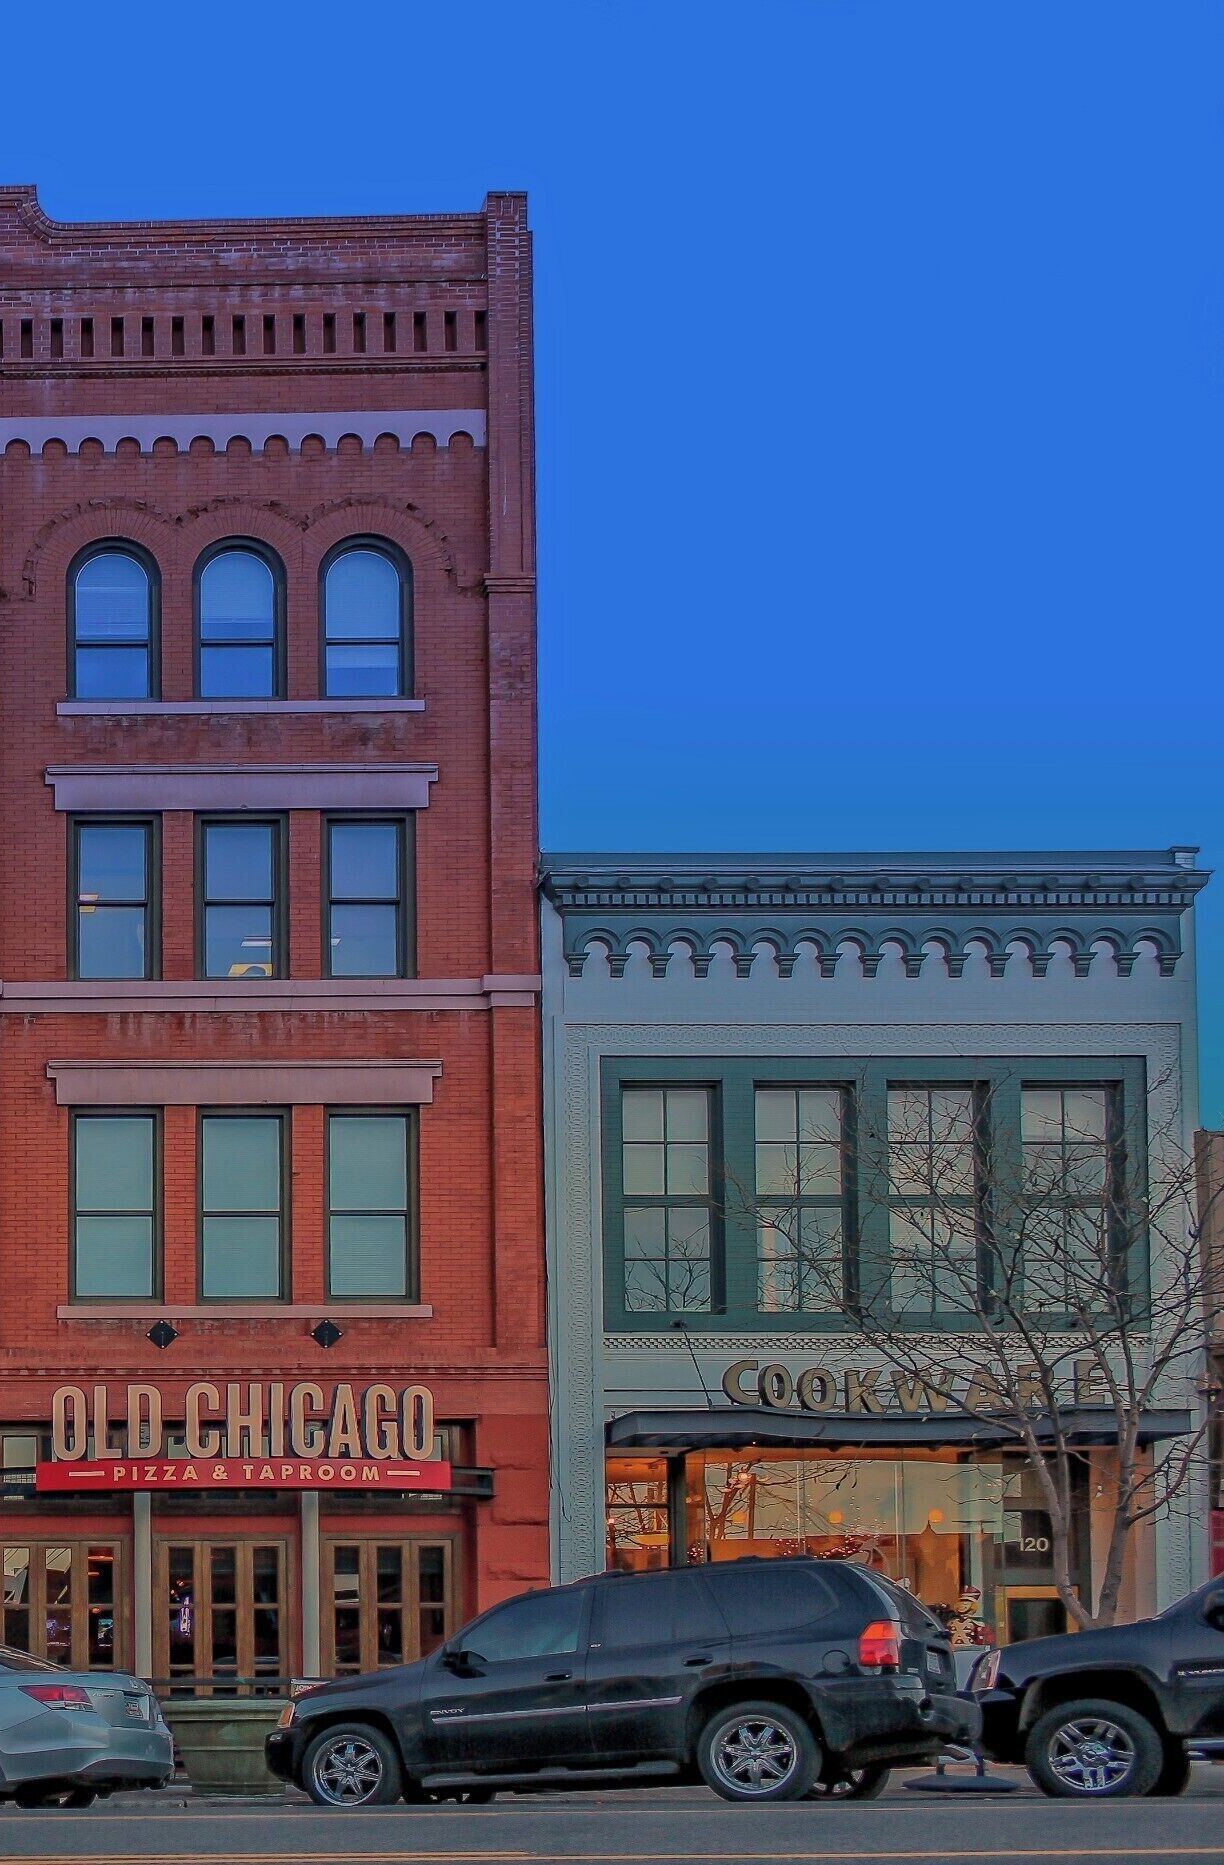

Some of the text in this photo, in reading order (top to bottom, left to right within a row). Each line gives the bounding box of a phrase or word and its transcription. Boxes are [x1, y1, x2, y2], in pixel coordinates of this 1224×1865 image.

[721, 1359, 1106, 1413] COOKWARE
[52, 1382, 436, 1462] OLD CHICAGO
[112, 1464, 382, 1482] PIZZA & TAPROOM
[1019, 1537, 1049, 1552] 120
